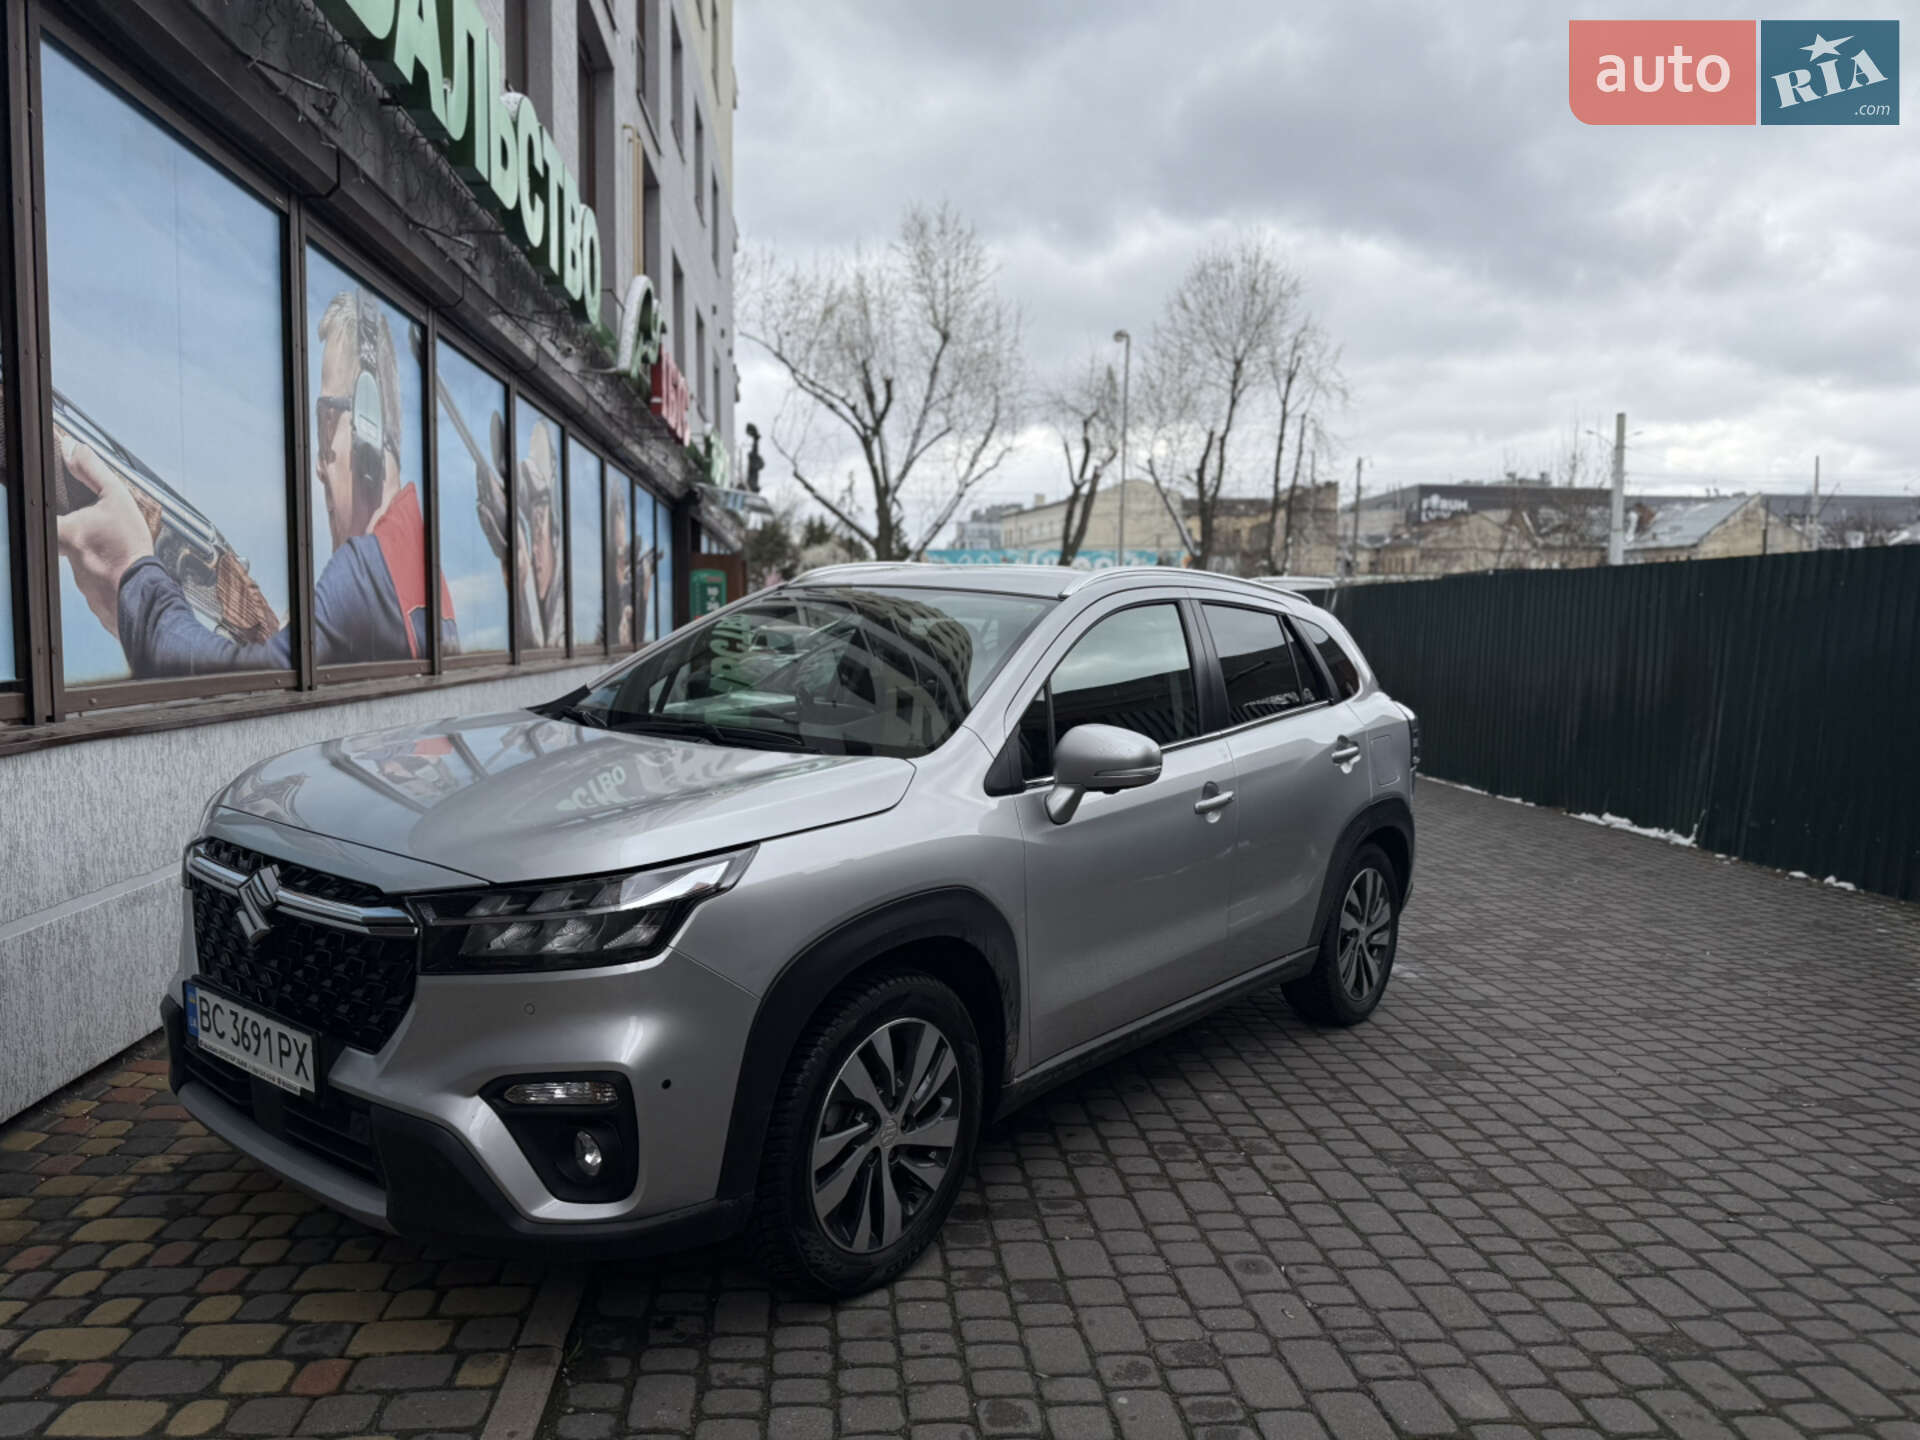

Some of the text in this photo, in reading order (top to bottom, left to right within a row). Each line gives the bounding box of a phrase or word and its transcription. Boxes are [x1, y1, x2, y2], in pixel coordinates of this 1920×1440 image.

[344, 0, 601, 325] АЛЬСТВО
[198, 996, 225, 1040] BC
[229, 1009, 273, 1065] 3691
[277, 1031, 310, 1081] PX
